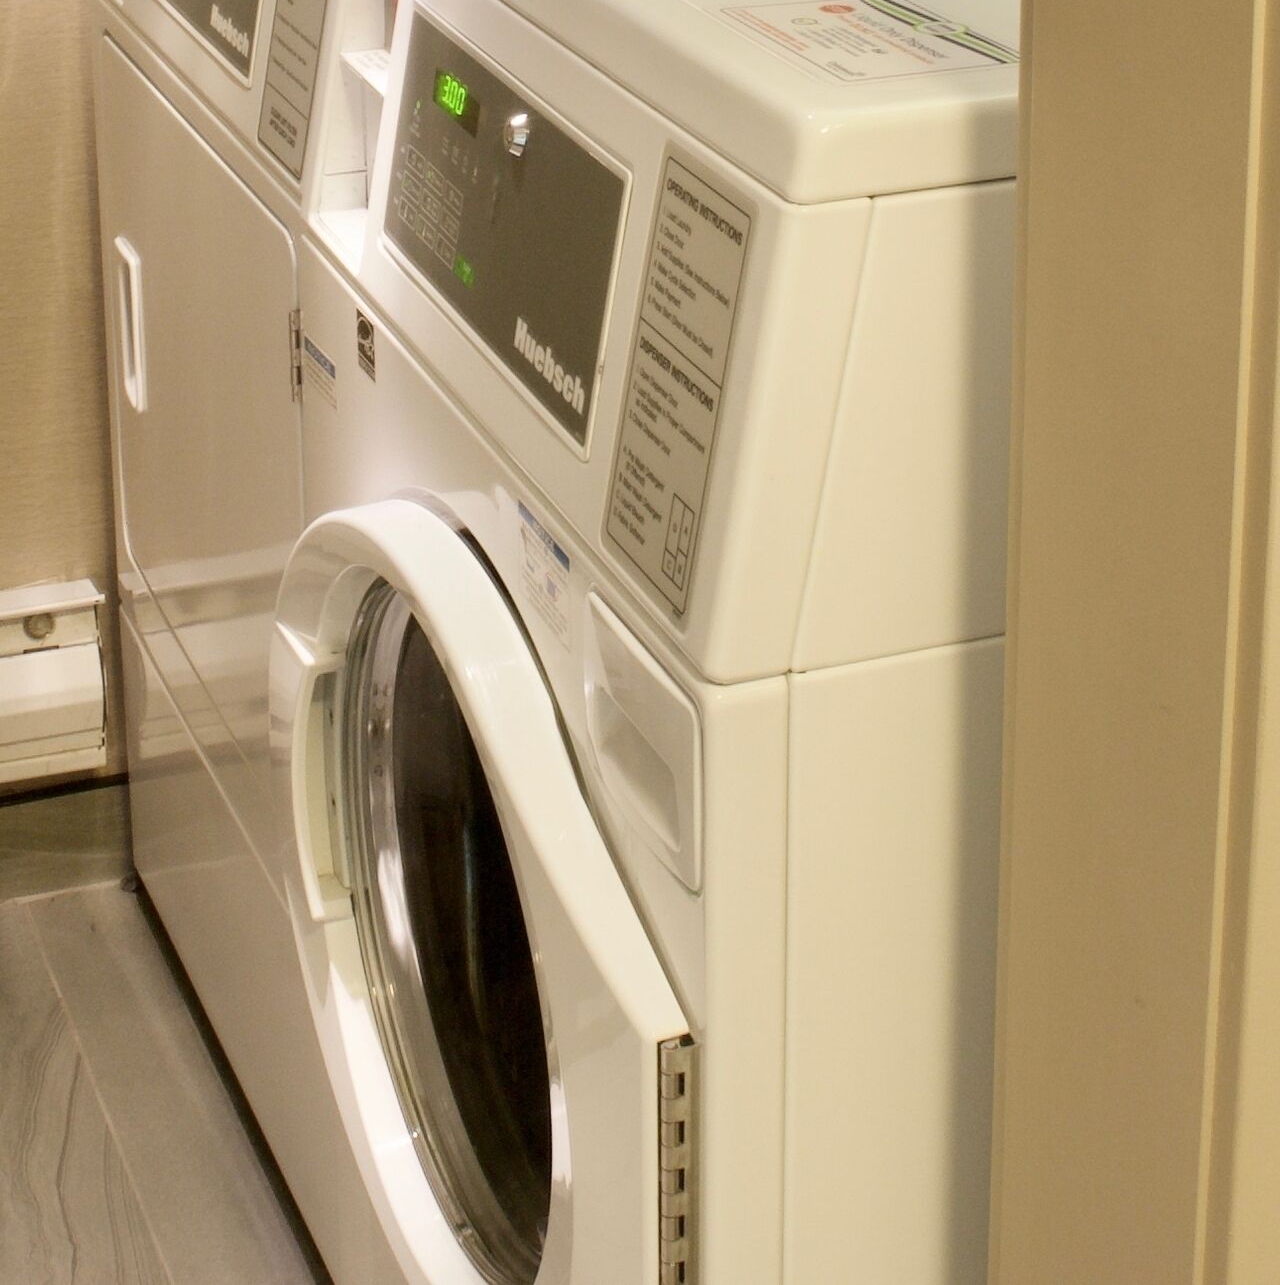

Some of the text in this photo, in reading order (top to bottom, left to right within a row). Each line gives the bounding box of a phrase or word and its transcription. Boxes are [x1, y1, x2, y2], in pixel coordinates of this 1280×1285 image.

[210, 3, 250, 57] Huebsch
[666, 176, 743, 247] OPERATING INSTRUCTIONS
[513, 317, 586, 415] Huebsch
[639, 334, 714, 413] DISPENSER INSTRUCTIONS
